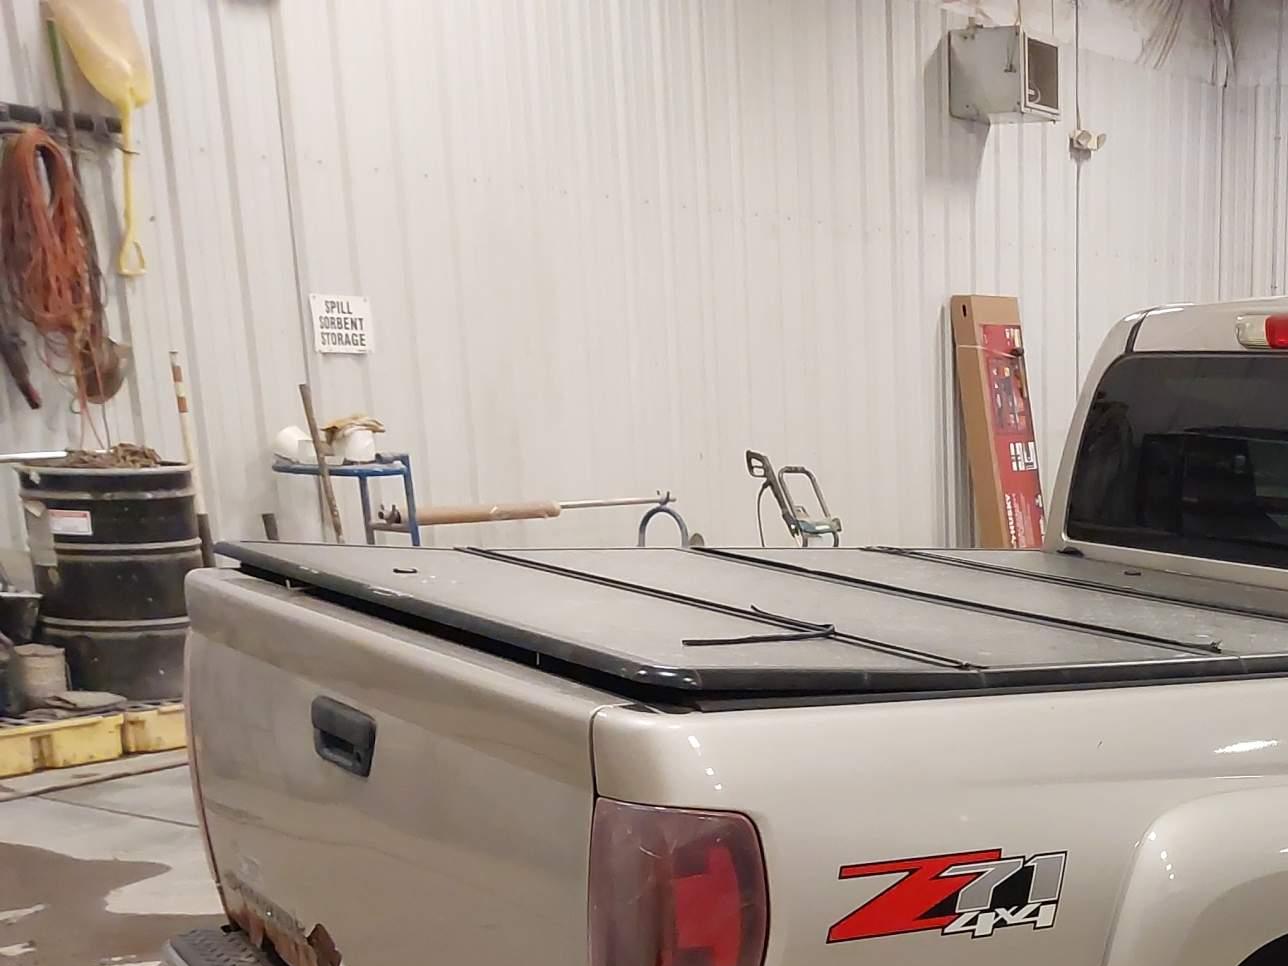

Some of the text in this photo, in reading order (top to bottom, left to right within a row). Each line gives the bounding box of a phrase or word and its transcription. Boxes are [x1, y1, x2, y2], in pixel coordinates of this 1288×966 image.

[324, 300, 353, 315] SPILL
[319, 315, 364, 331] SORBENT
[320, 331, 367, 347] STORAGE
[1004, 493, 1016, 534] HUSKY
[826, 847, 1068, 944] Z71
